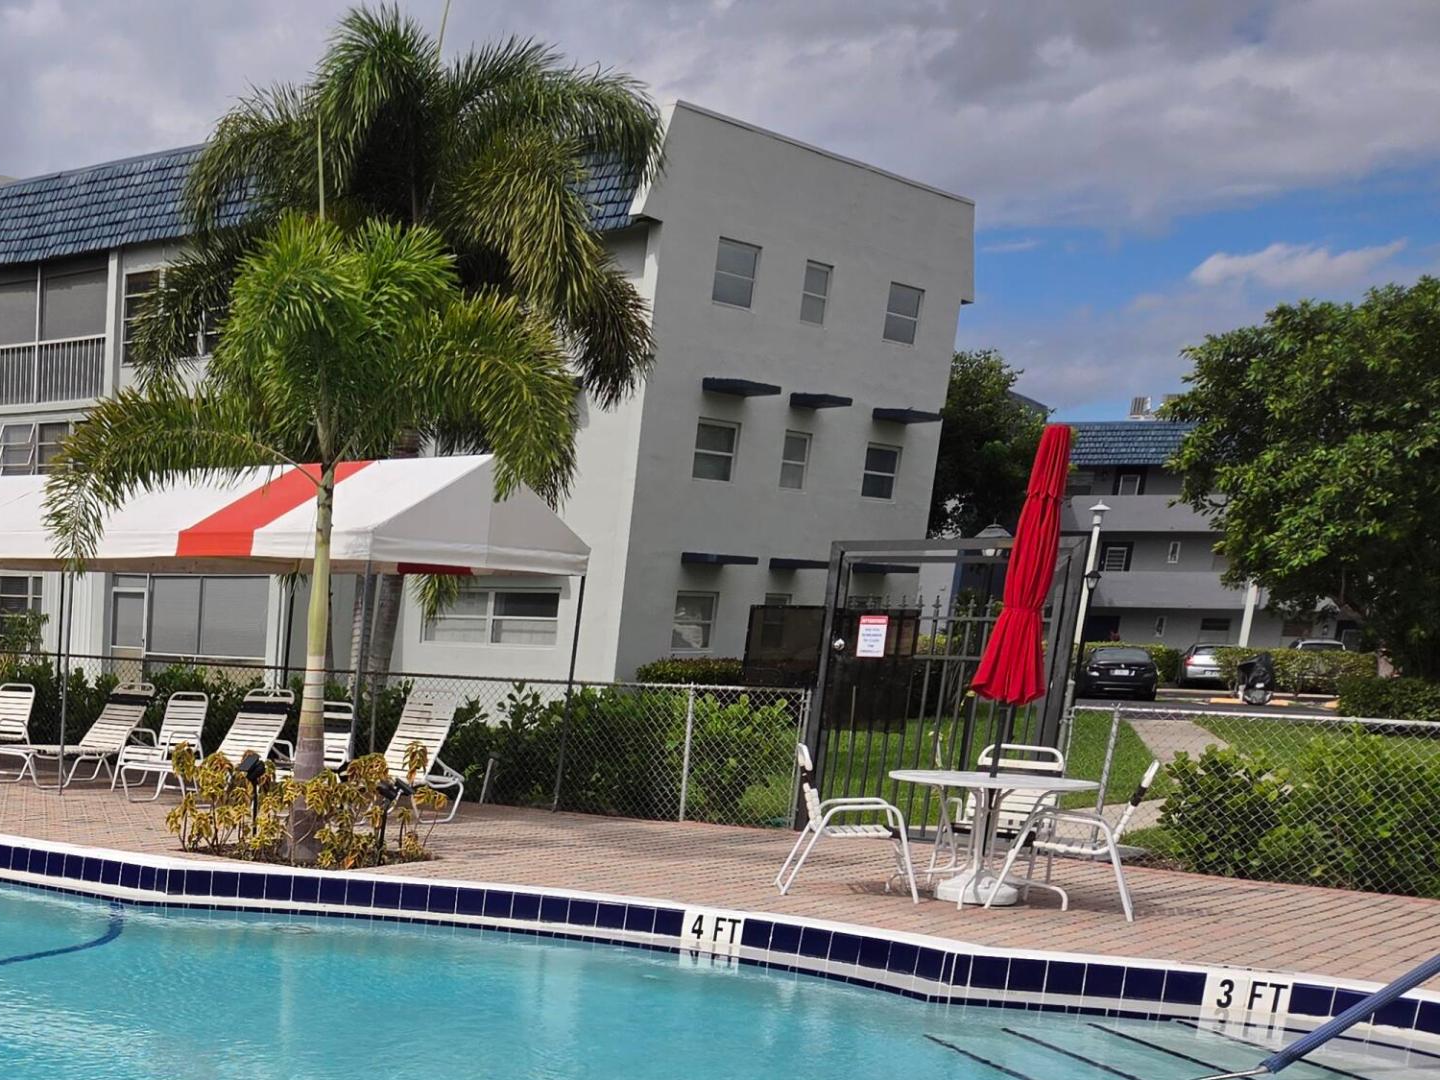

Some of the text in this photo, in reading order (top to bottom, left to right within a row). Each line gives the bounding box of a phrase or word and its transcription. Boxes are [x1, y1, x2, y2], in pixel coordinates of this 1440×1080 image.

[691, 914, 742, 945] 4 FT
[1216, 979, 1289, 1013] 3 FT
